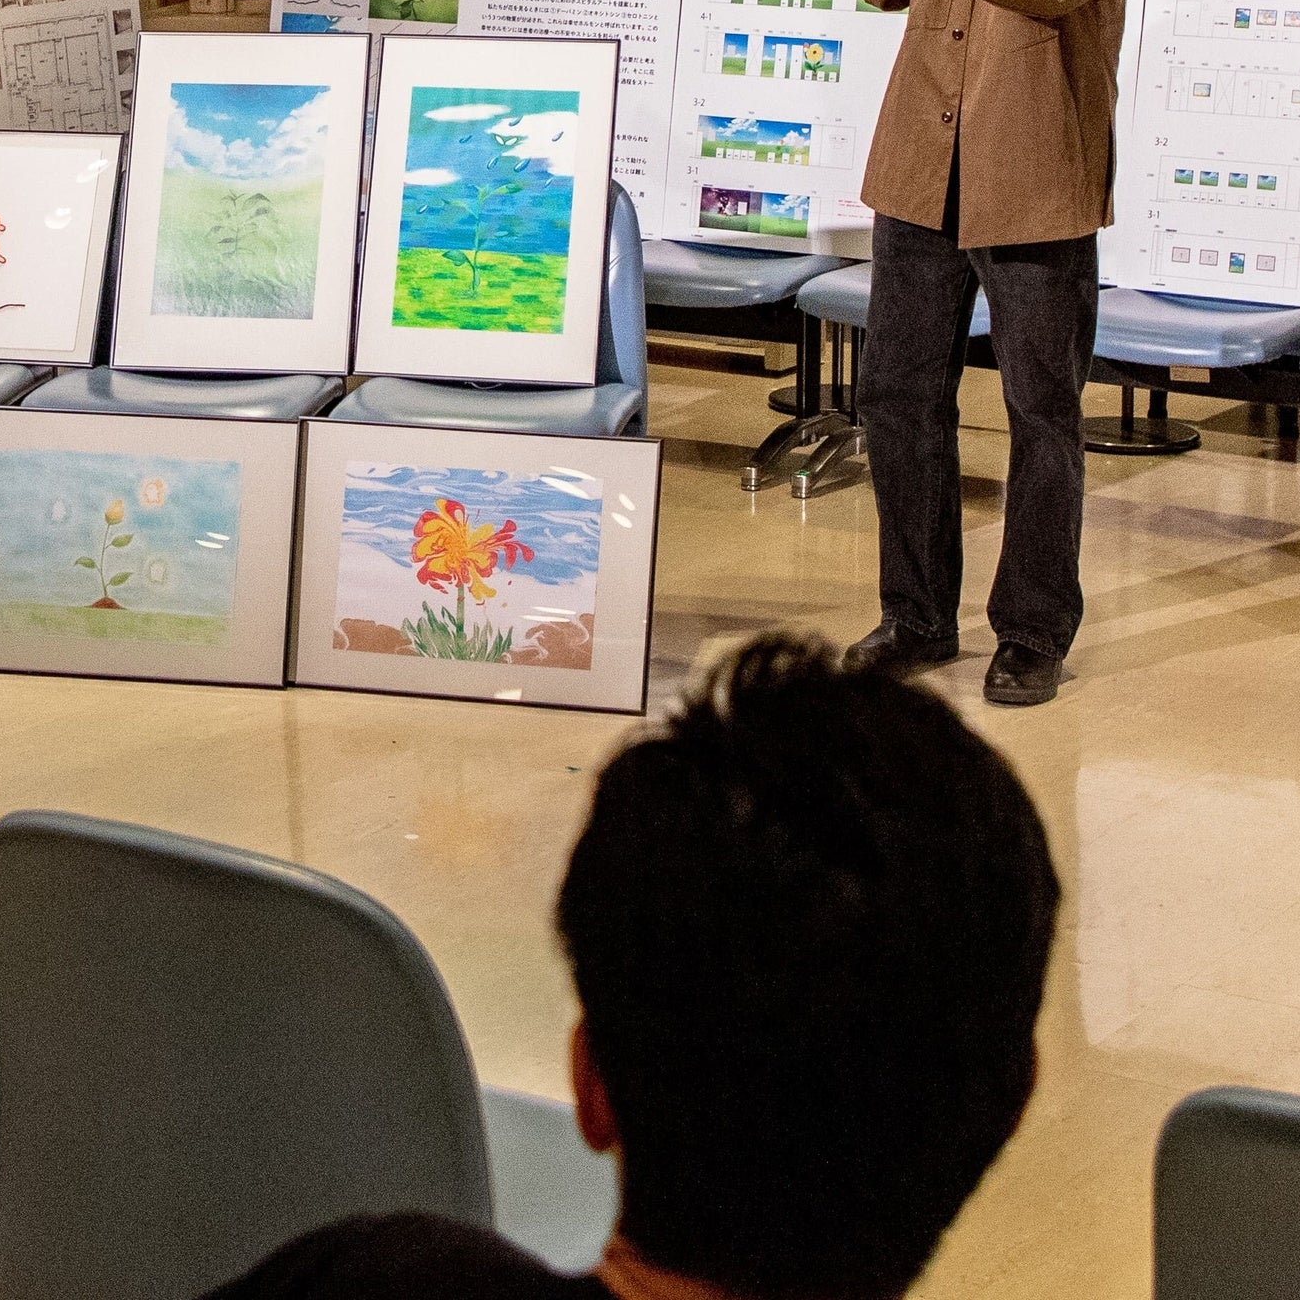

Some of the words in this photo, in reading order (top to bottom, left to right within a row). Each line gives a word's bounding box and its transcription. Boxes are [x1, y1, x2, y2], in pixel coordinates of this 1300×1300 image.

[700, 12, 712, 20] 4-1
[1163, 46, 1176, 55] 4-1
[693, 97, 706, 107] 3-2
[1154, 137, 1168, 146] 3-2
[687, 166, 698, 175] 3-1
[1147, 210, 1160, 219] 3-1
